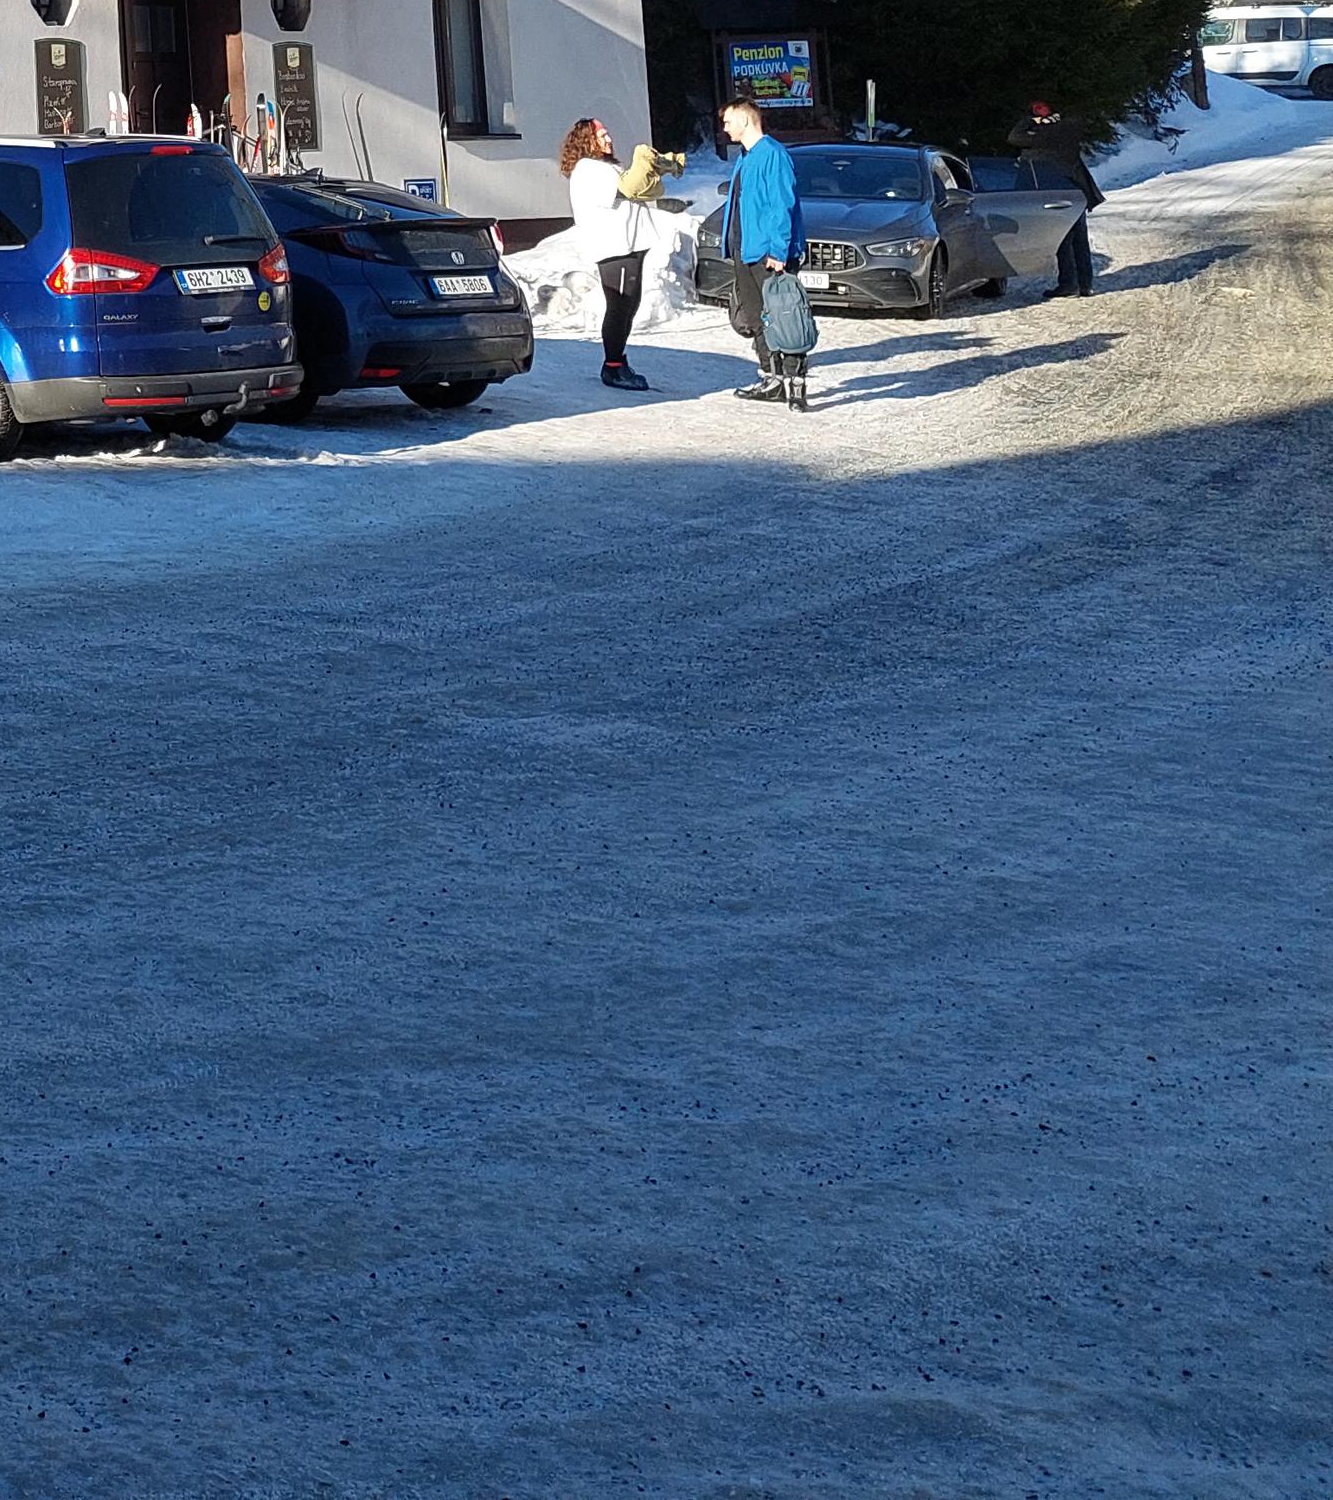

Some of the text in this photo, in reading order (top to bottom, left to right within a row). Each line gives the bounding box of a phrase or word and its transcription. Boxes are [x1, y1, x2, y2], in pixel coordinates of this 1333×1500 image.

[733, 44, 784, 62] Penzion
[187, 268, 247, 286] 6H2 2439
[799, 275, 823, 286] 130
[437, 278, 488, 293] 6AA 5806
